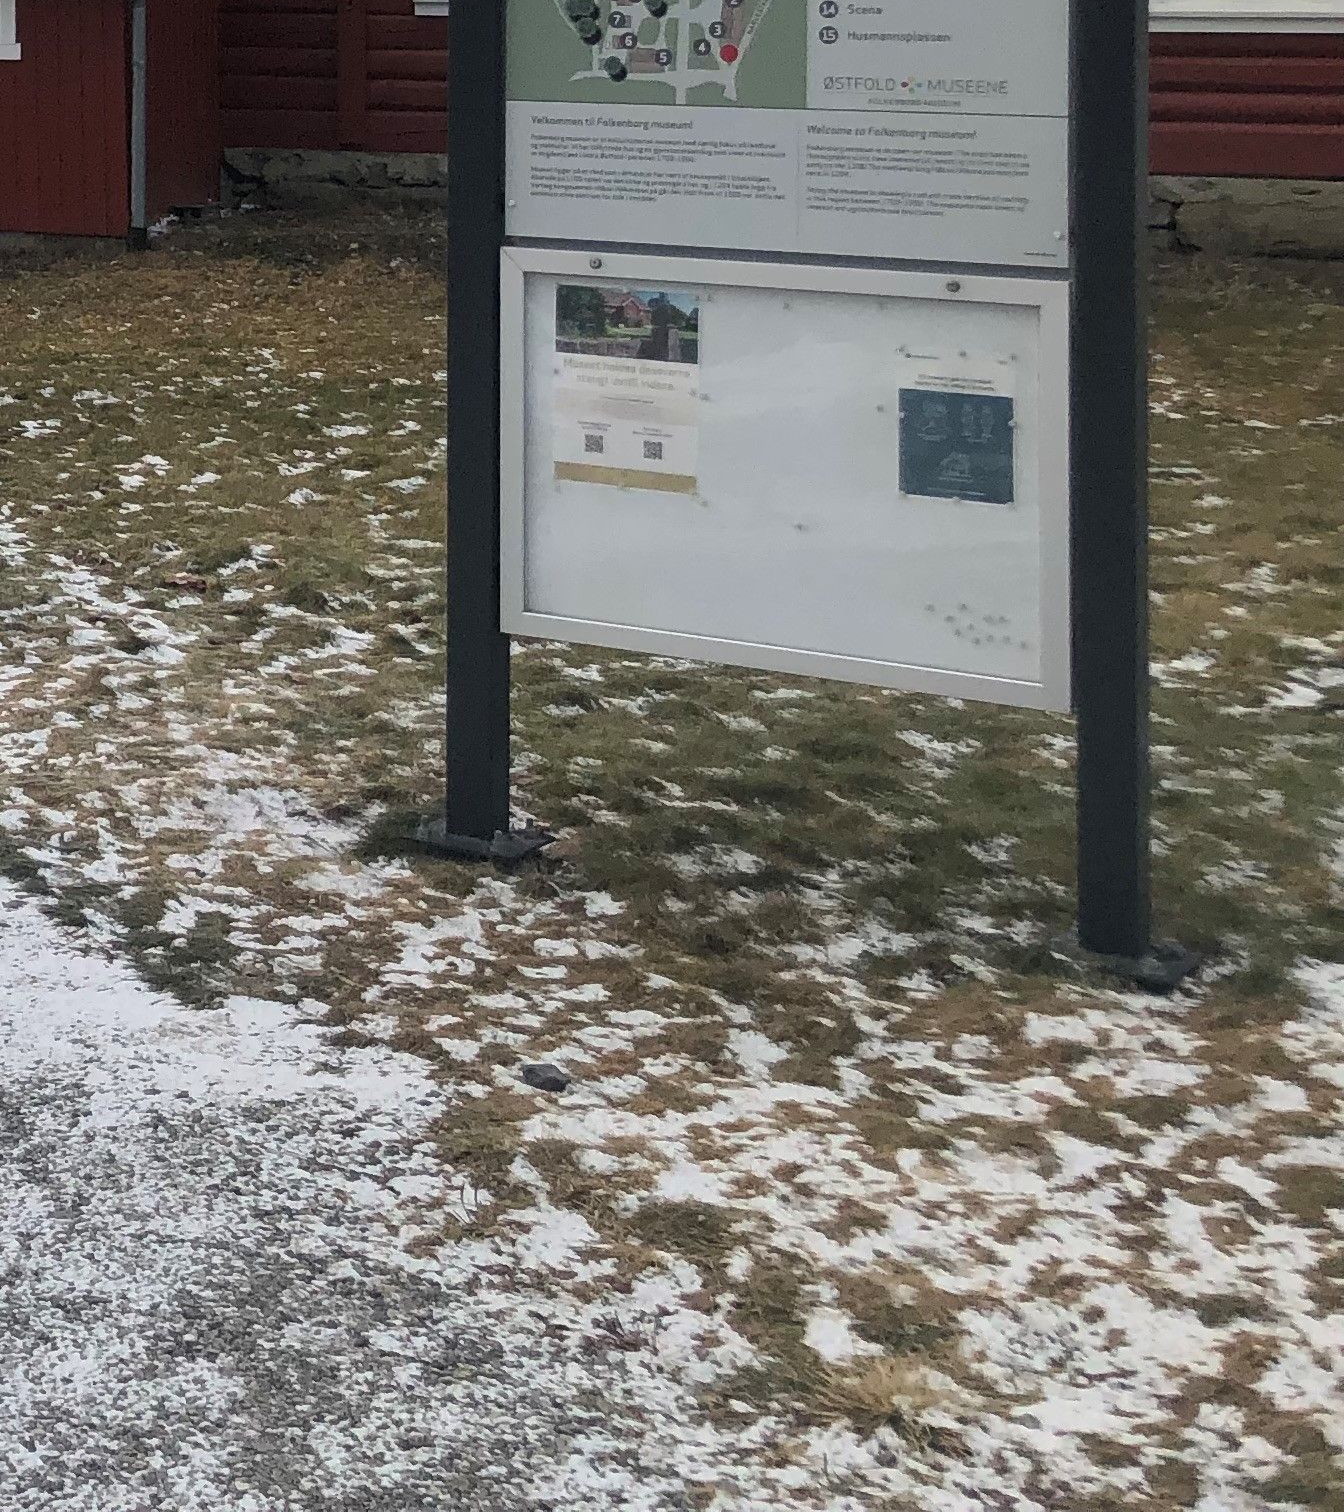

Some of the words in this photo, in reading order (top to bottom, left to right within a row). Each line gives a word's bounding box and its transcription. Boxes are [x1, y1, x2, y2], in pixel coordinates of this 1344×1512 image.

[823, 76, 896, 92] ØSTFOLD
[926, 80, 1009, 95] MUSEENE
[530, 115, 584, 127] Velkommen
[596, 117, 649, 131] Folkenborg
[806, 125, 853, 136] Welcome
[854, 127, 866, 136] to
[868, 127, 926, 140] Folkenborg
